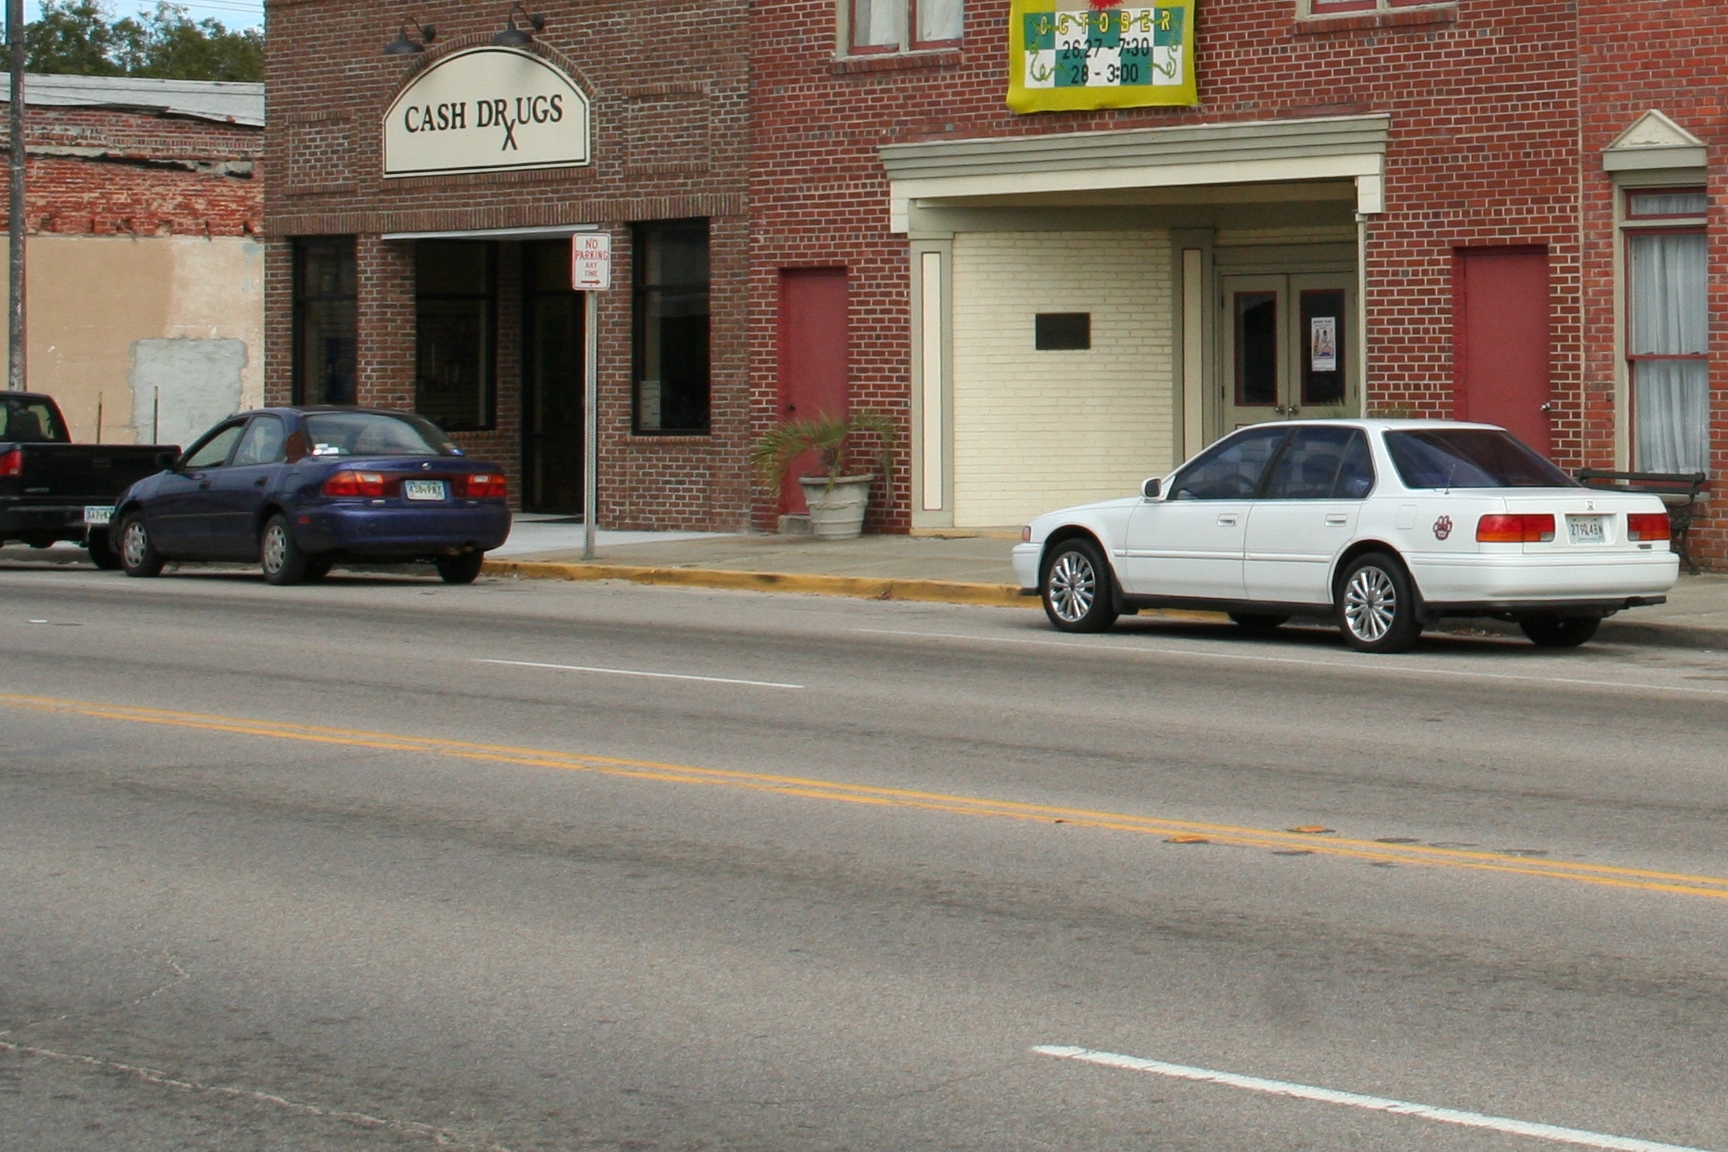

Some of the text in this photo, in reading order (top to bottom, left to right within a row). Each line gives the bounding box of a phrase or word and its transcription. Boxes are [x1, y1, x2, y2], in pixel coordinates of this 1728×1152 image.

[1040, 9, 1171, 35] OCTOBER
[1118, 38, 1149, 57] 7:30
[1071, 64, 1089, 84] 28
[1107, 64, 1138, 83] 3:00
[405, 101, 467, 133] CASH
[585, 239, 598, 249] NO
[575, 250, 609, 260] PARKING
